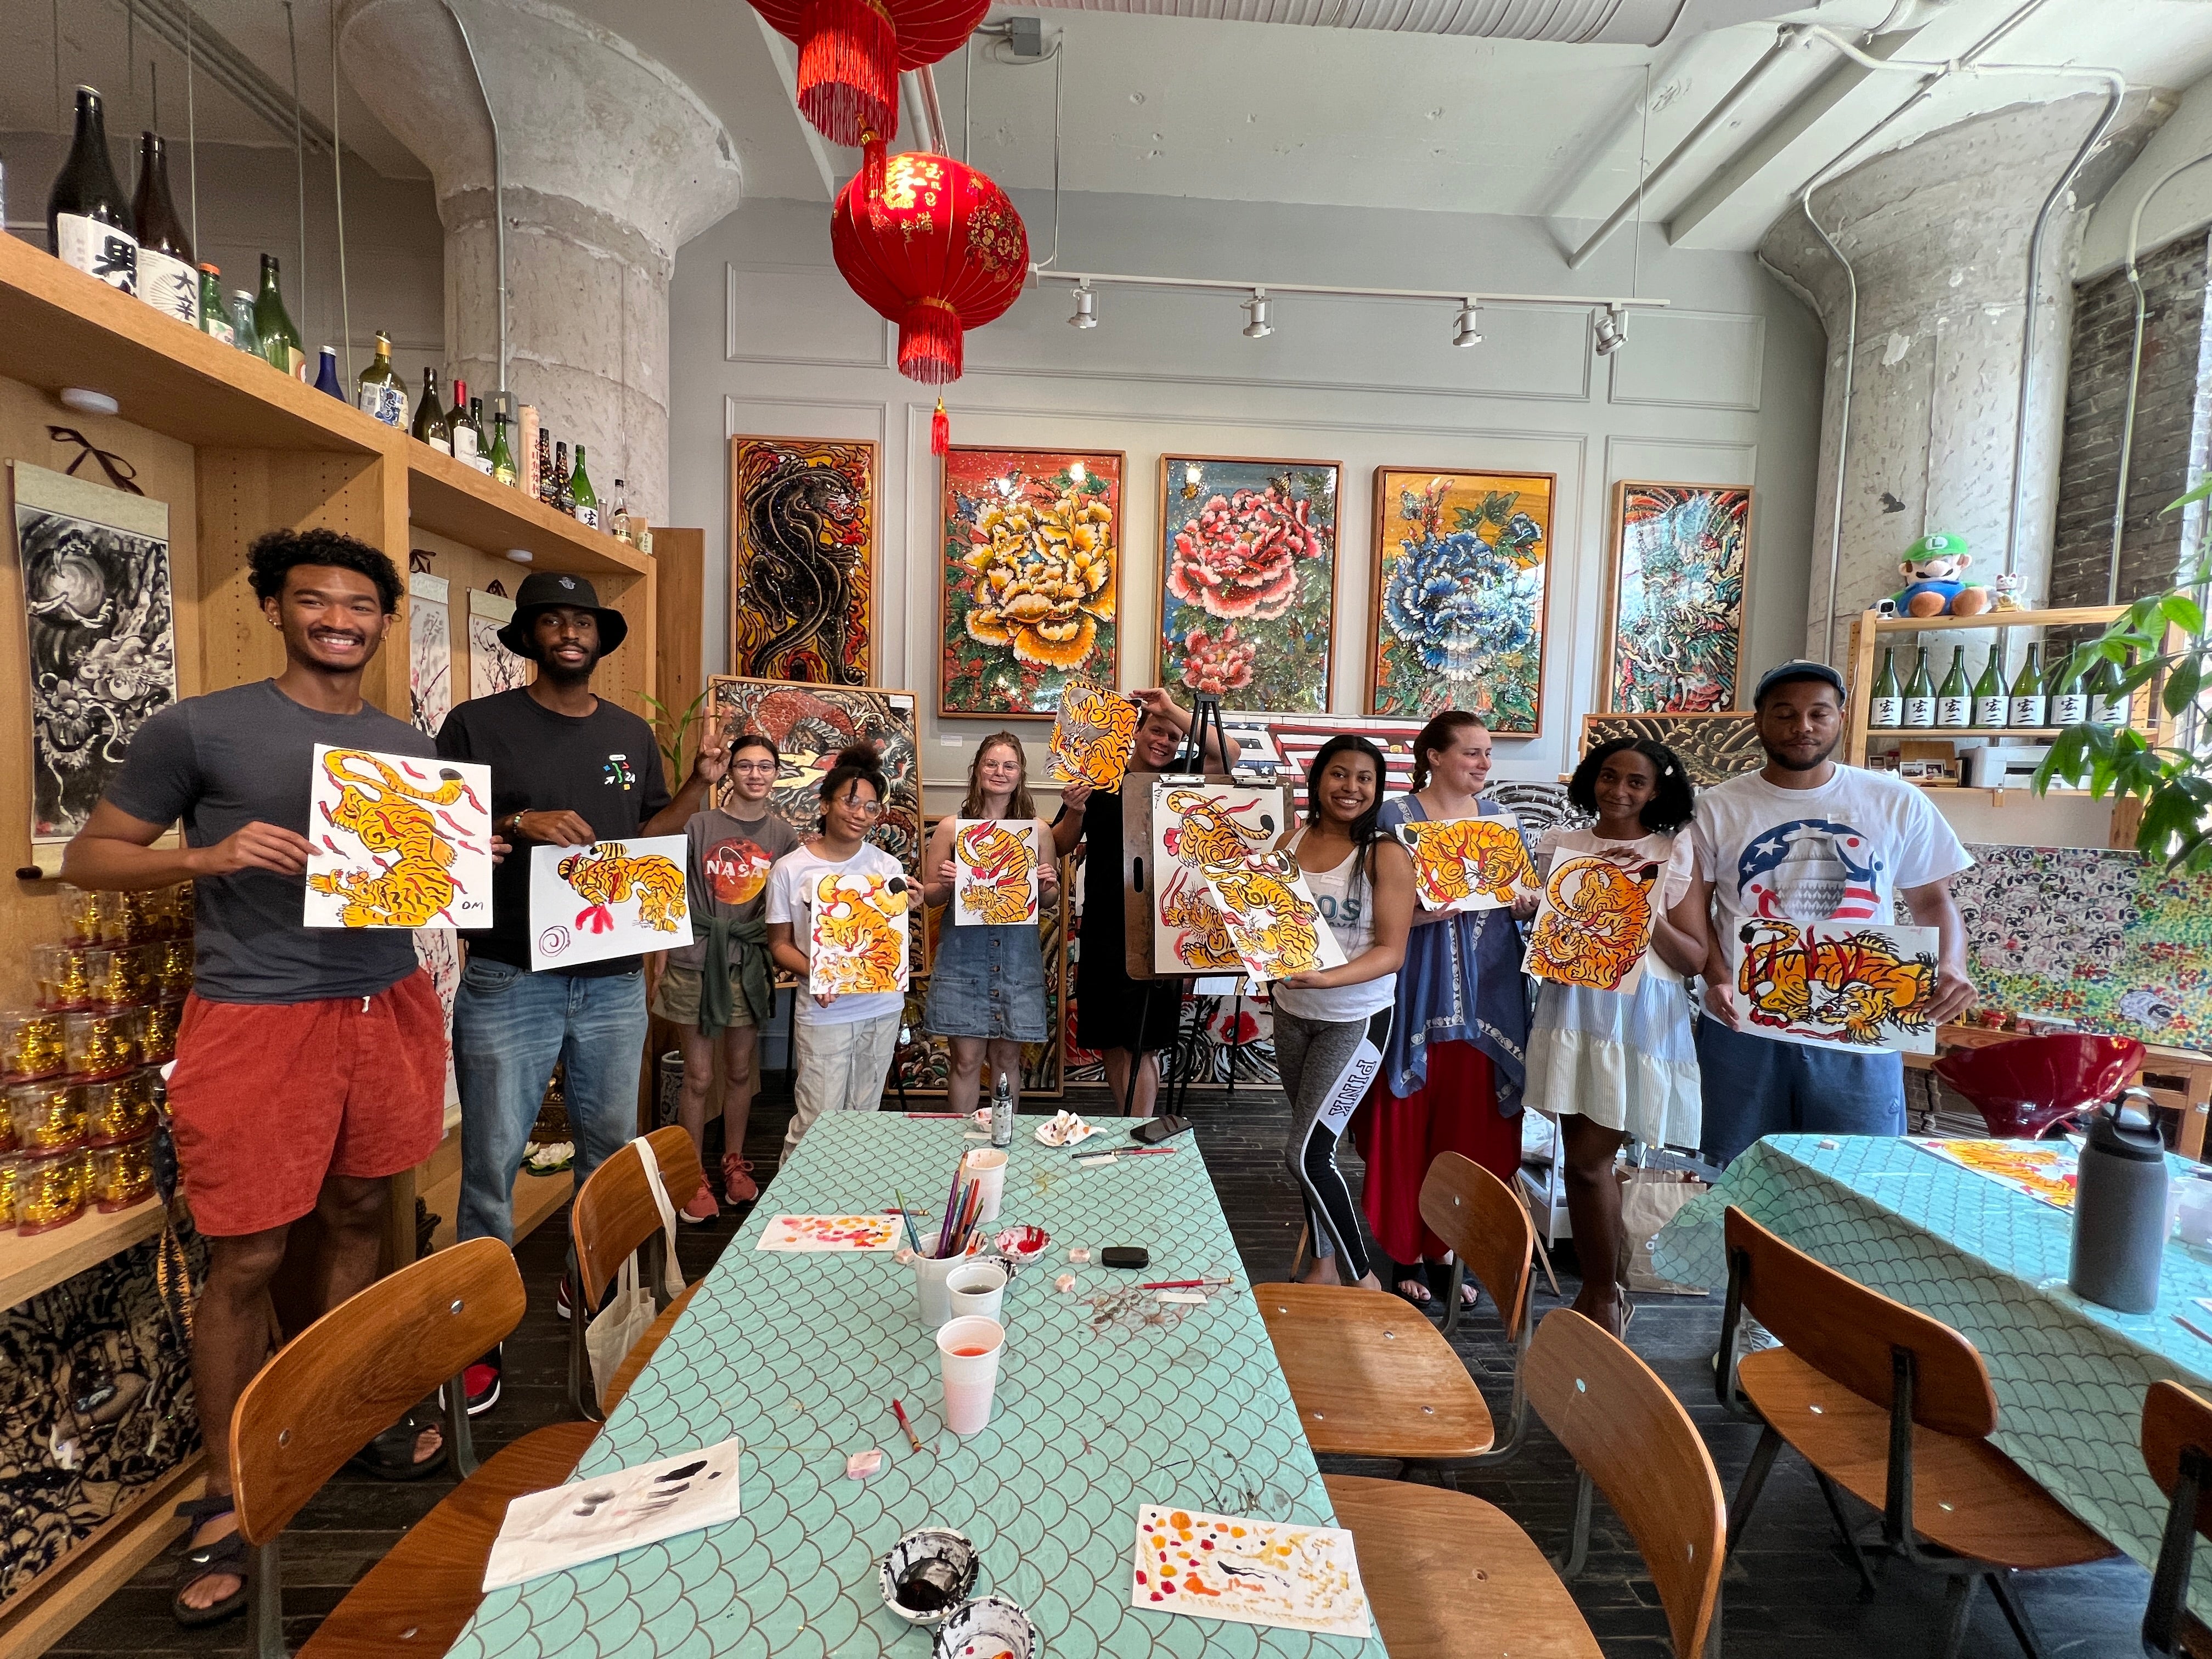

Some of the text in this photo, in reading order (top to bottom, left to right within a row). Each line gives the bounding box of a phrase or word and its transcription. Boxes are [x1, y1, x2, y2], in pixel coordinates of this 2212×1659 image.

[1932, 539, 1942, 547] L
[1879, 699, 1895, 722] 宏二
[1912, 699, 1928, 723] 宏二
[1945, 699, 1962, 722] 宏二
[1985, 698, 2002, 721] 宏二
[2017, 698, 2035, 723] 宏二
[2061, 697, 2079, 721] 宏二
[624, 771, 635, 783] 24
[707, 860, 763, 878] NASA
[1328, 1059, 1377, 1116] PINK
